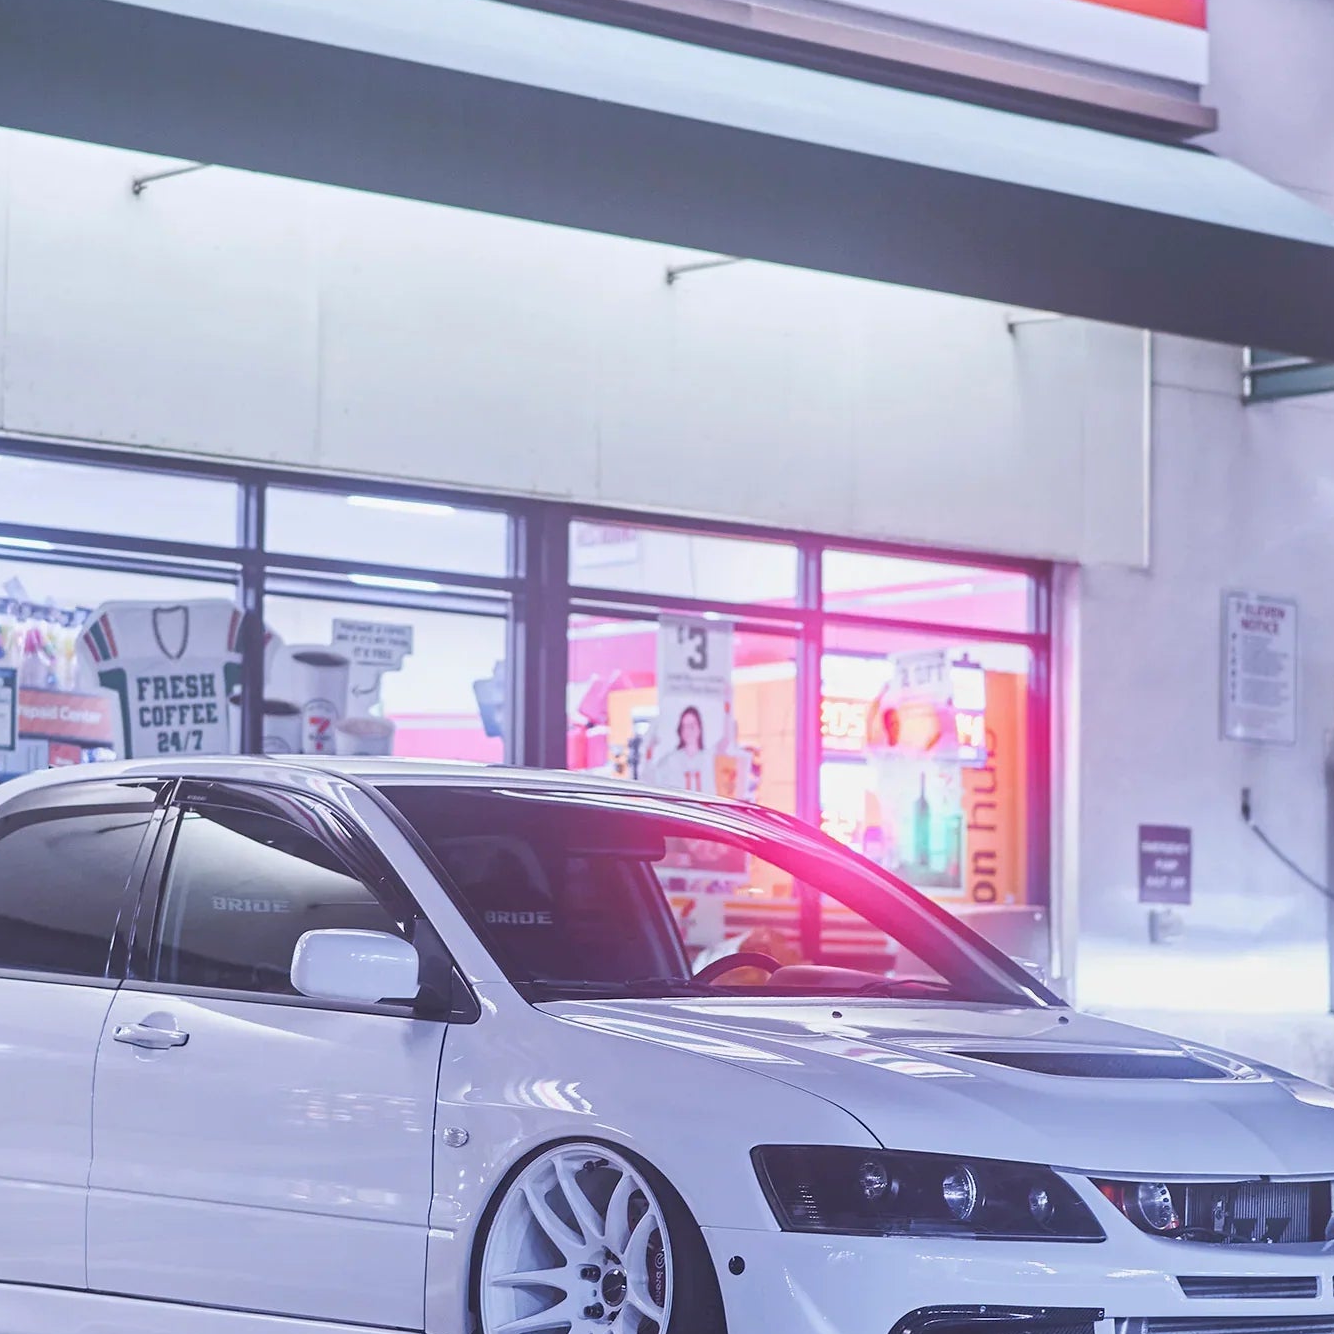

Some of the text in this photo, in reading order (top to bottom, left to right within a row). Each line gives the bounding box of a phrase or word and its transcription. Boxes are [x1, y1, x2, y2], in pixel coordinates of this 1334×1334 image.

[137, 673, 216, 701] FRESH
[139, 703, 218, 727] COFFEE
[157, 730, 203, 753] 24/7
[211, 896, 292, 913] BRIDE
[485, 909, 553, 925] BRIDE
